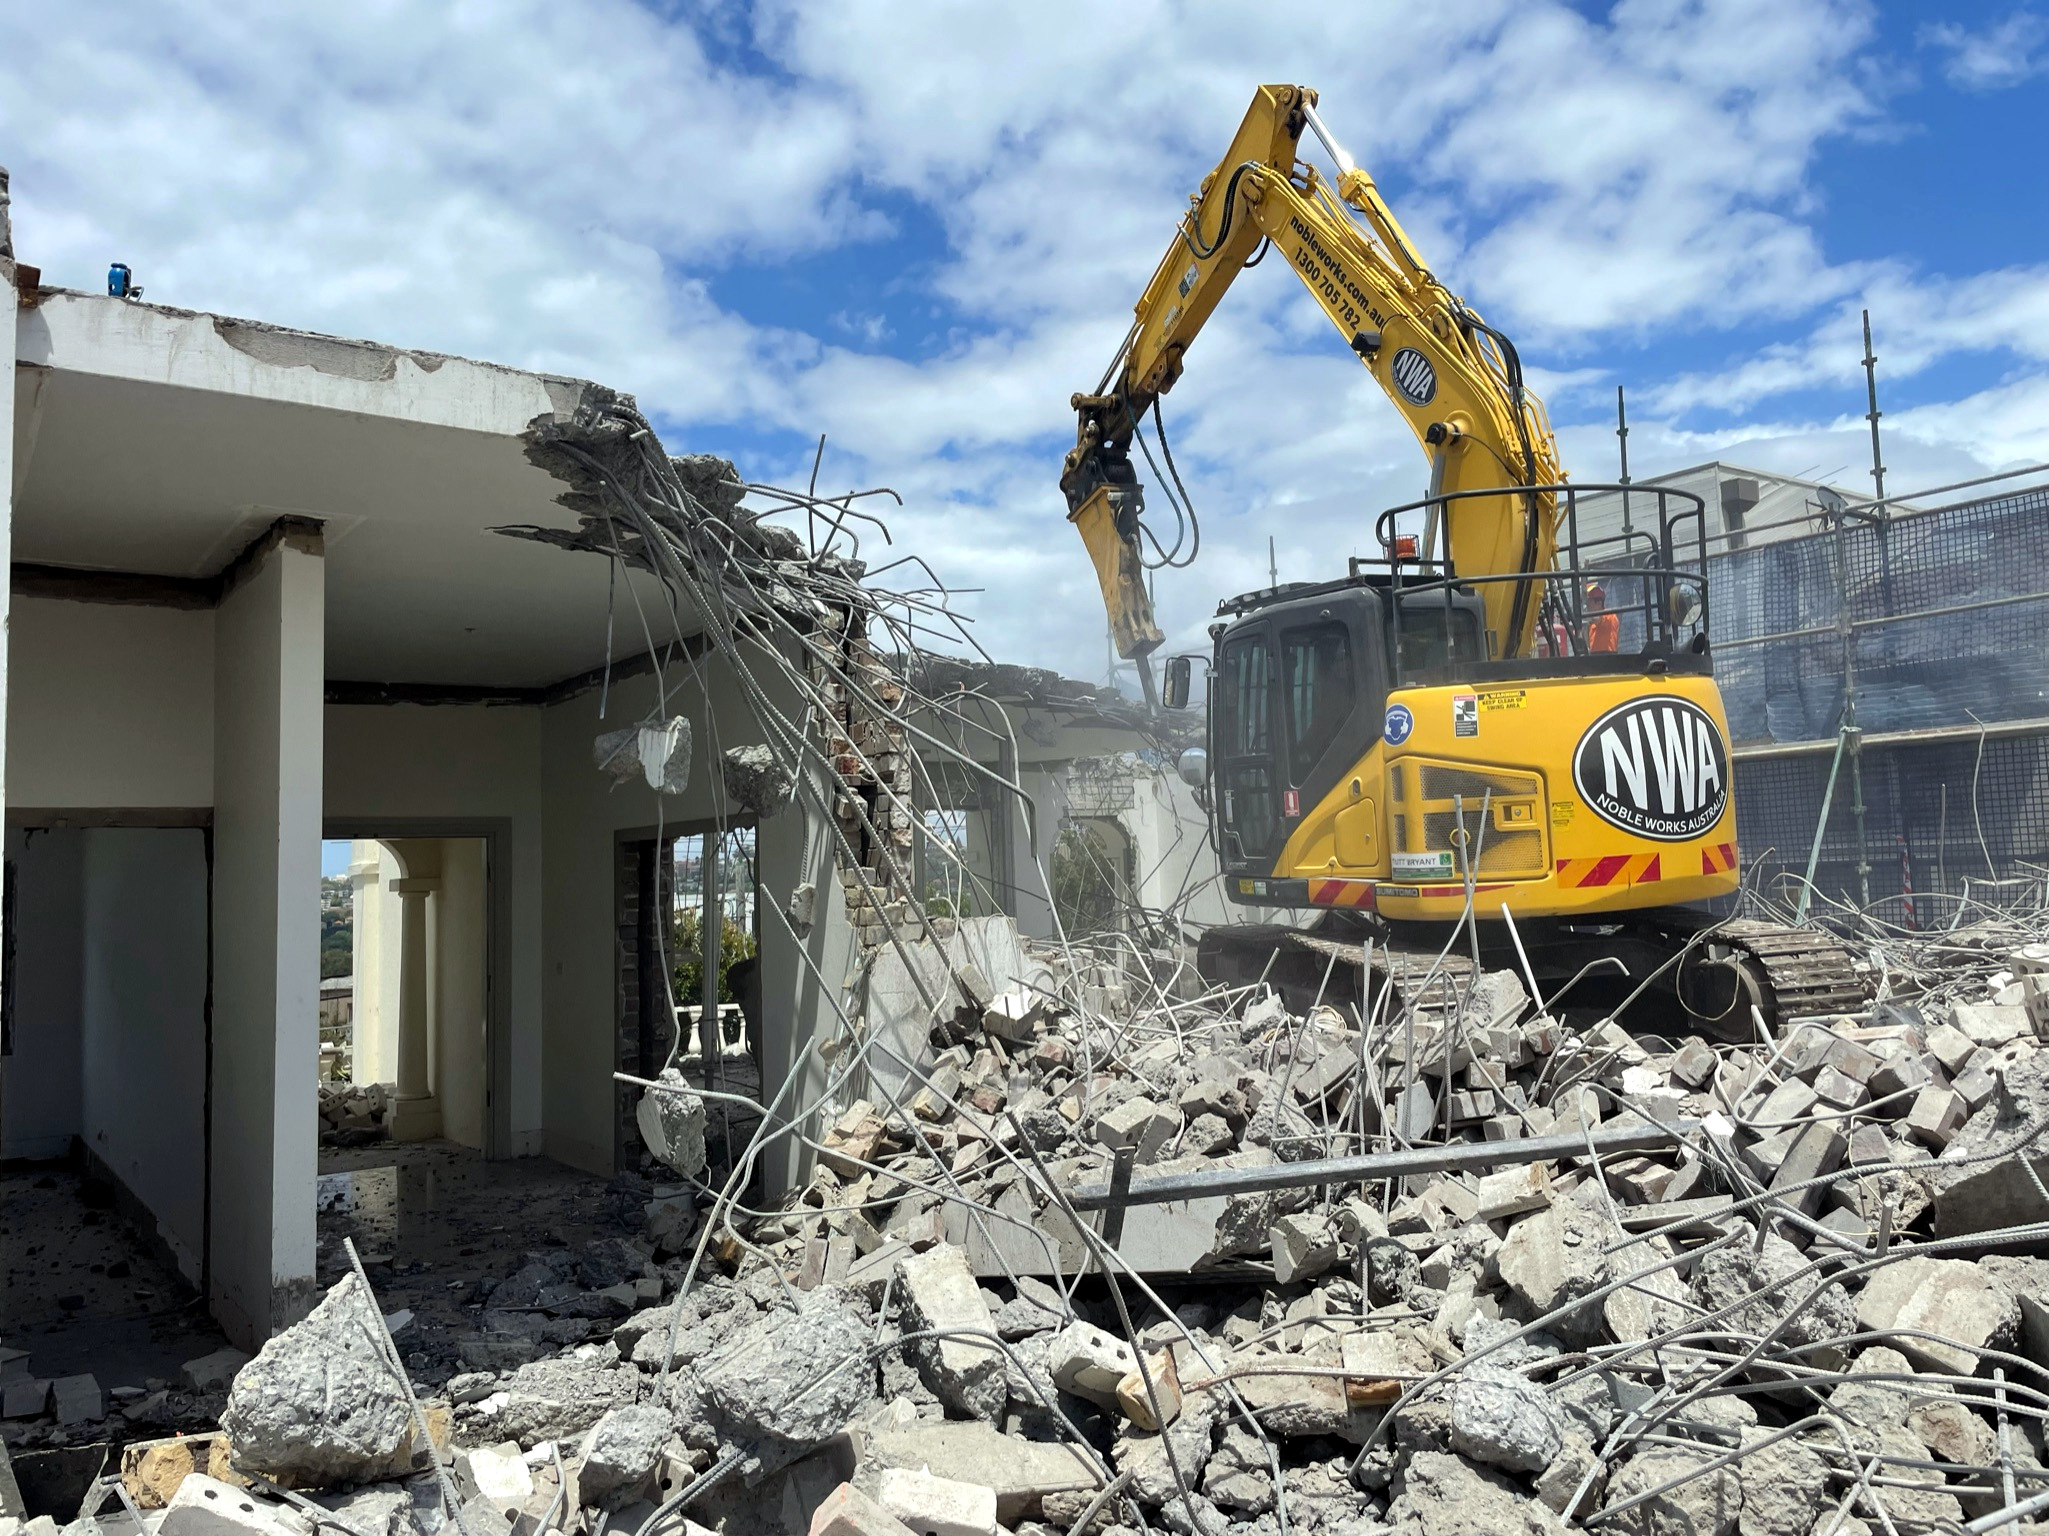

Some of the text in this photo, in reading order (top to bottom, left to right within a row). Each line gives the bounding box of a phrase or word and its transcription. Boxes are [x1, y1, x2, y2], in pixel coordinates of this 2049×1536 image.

[1290, 216, 1384, 328] nobleworks.com.au
[1294, 247, 1360, 331] 1300 705 782
[1396, 351, 1433, 398] NWA
[1600, 707, 1720, 814] NWA
[1596, 793, 1643, 826] NOBLE
[1644, 816, 1687, 833] WORKS
[1688, 789, 1725, 831] AUSTRALIA
[1407, 858, 1436, 866] BRYANT
[1376, 887, 1418, 896] SUMITOMO
